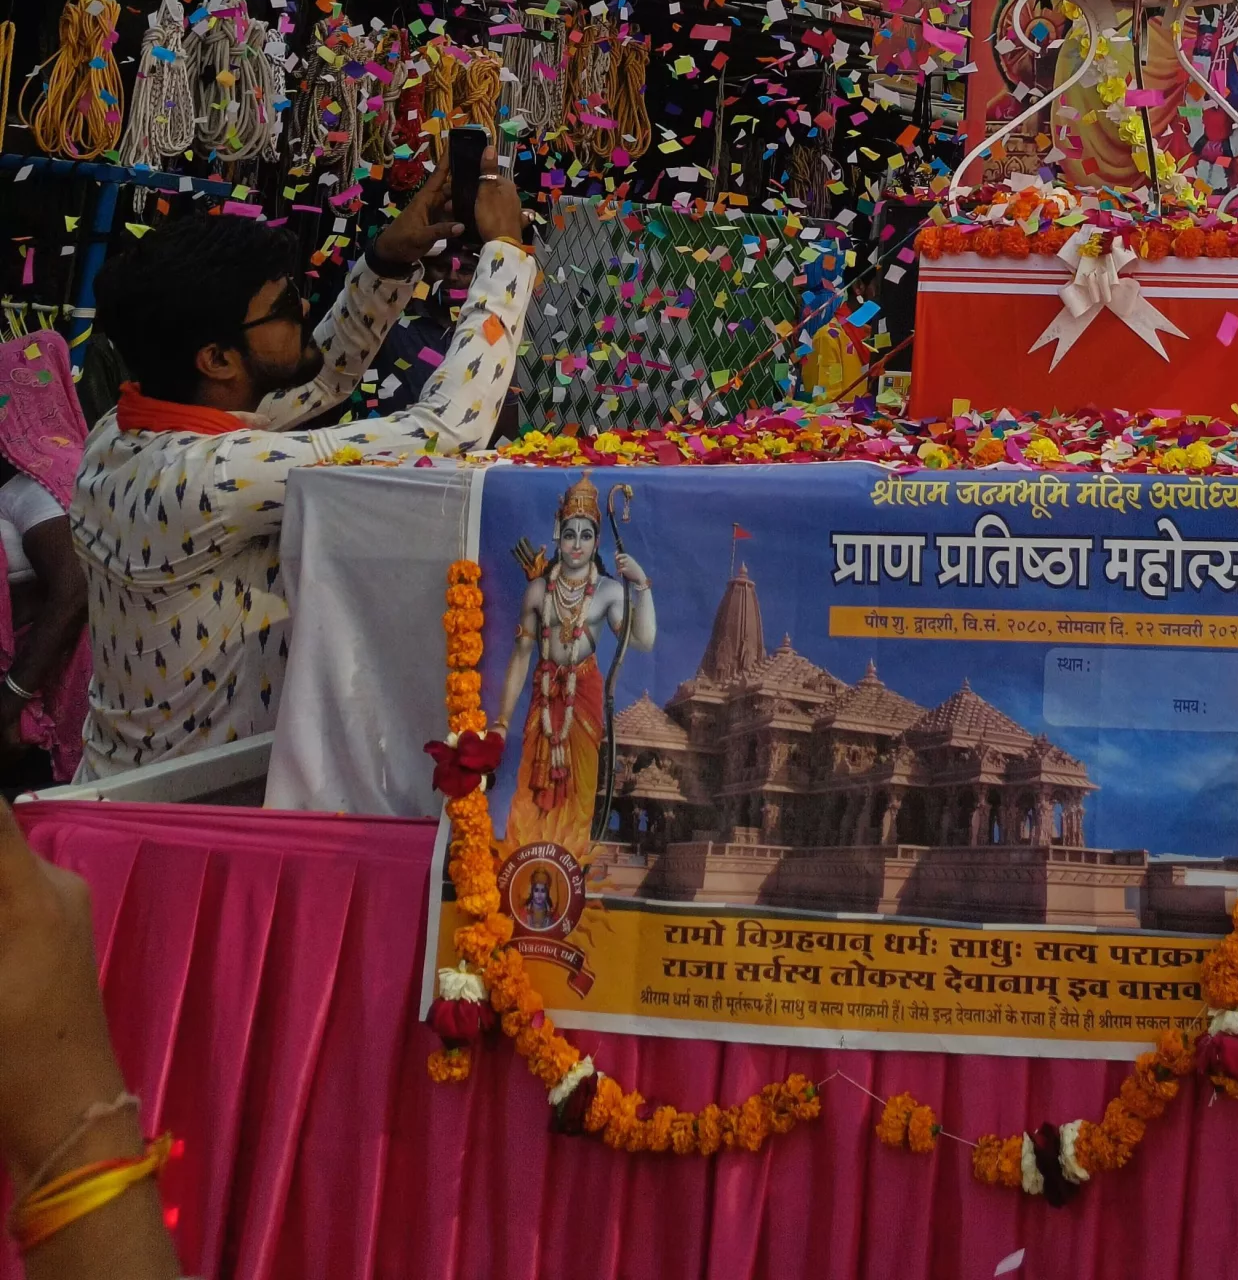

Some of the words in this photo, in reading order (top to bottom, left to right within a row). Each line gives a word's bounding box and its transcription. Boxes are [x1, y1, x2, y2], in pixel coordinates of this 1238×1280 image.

[870, 474, 950, 506] श्रीराम
[956, 474, 1071, 519] जन्मभूमि
[1076, 474, 1142, 514] मंदिर
[831, 532, 927, 584] प्राण
[935, 513, 1093, 588] प्रतिष्ठा
[864, 610, 888, 629] पौष
[914, 613, 958, 635] द्वादशी,
[1007, 618, 1052, 636] २०८०,
[1057, 615, 1106, 635] सोमवार
[1136, 622, 1154, 637] २२
[1159, 619, 1203, 638] जनवरी
[664, 920, 726, 946] रामो
[736, 920, 875, 961] विग्रहवान्
[884, 928, 937, 956] धर्मः
[950, 938, 1022, 967] साधुः
[1034, 942, 1099, 964] सत्य
[662, 957, 728, 981] राजा
[735, 955, 823, 985] सर्वस्य
[829, 959, 937, 991] लोकस्य
[944, 964, 1060, 1004] देवानाम्
[1066, 977, 1110, 1000] इव
[640, 985, 669, 1006] श्रीराम
[673, 988, 690, 1007] धर्म
[693, 993, 709, 1009] का
[712, 989, 722, 1013] ही
[781, 999, 806, 1019] साधु
[808, 1000, 817, 1015] व
[820, 1001, 843, 1016] सत्य
[847, 997, 889, 1019] पराक्रमी
[908, 1001, 929, 1021] जैसे
[955, 1002, 1002, 1025] देवताओं
[1004, 1004, 1020, 1025] के
[1021, 1010, 1045, 1026] राजा
[1059, 1006, 1079, 1028] वैसे
[1082, 1008, 1095, 1032] ही
[1098, 1009, 1132, 1030] श्रीराम
[1136, 1015, 1170, 1030] सकल
